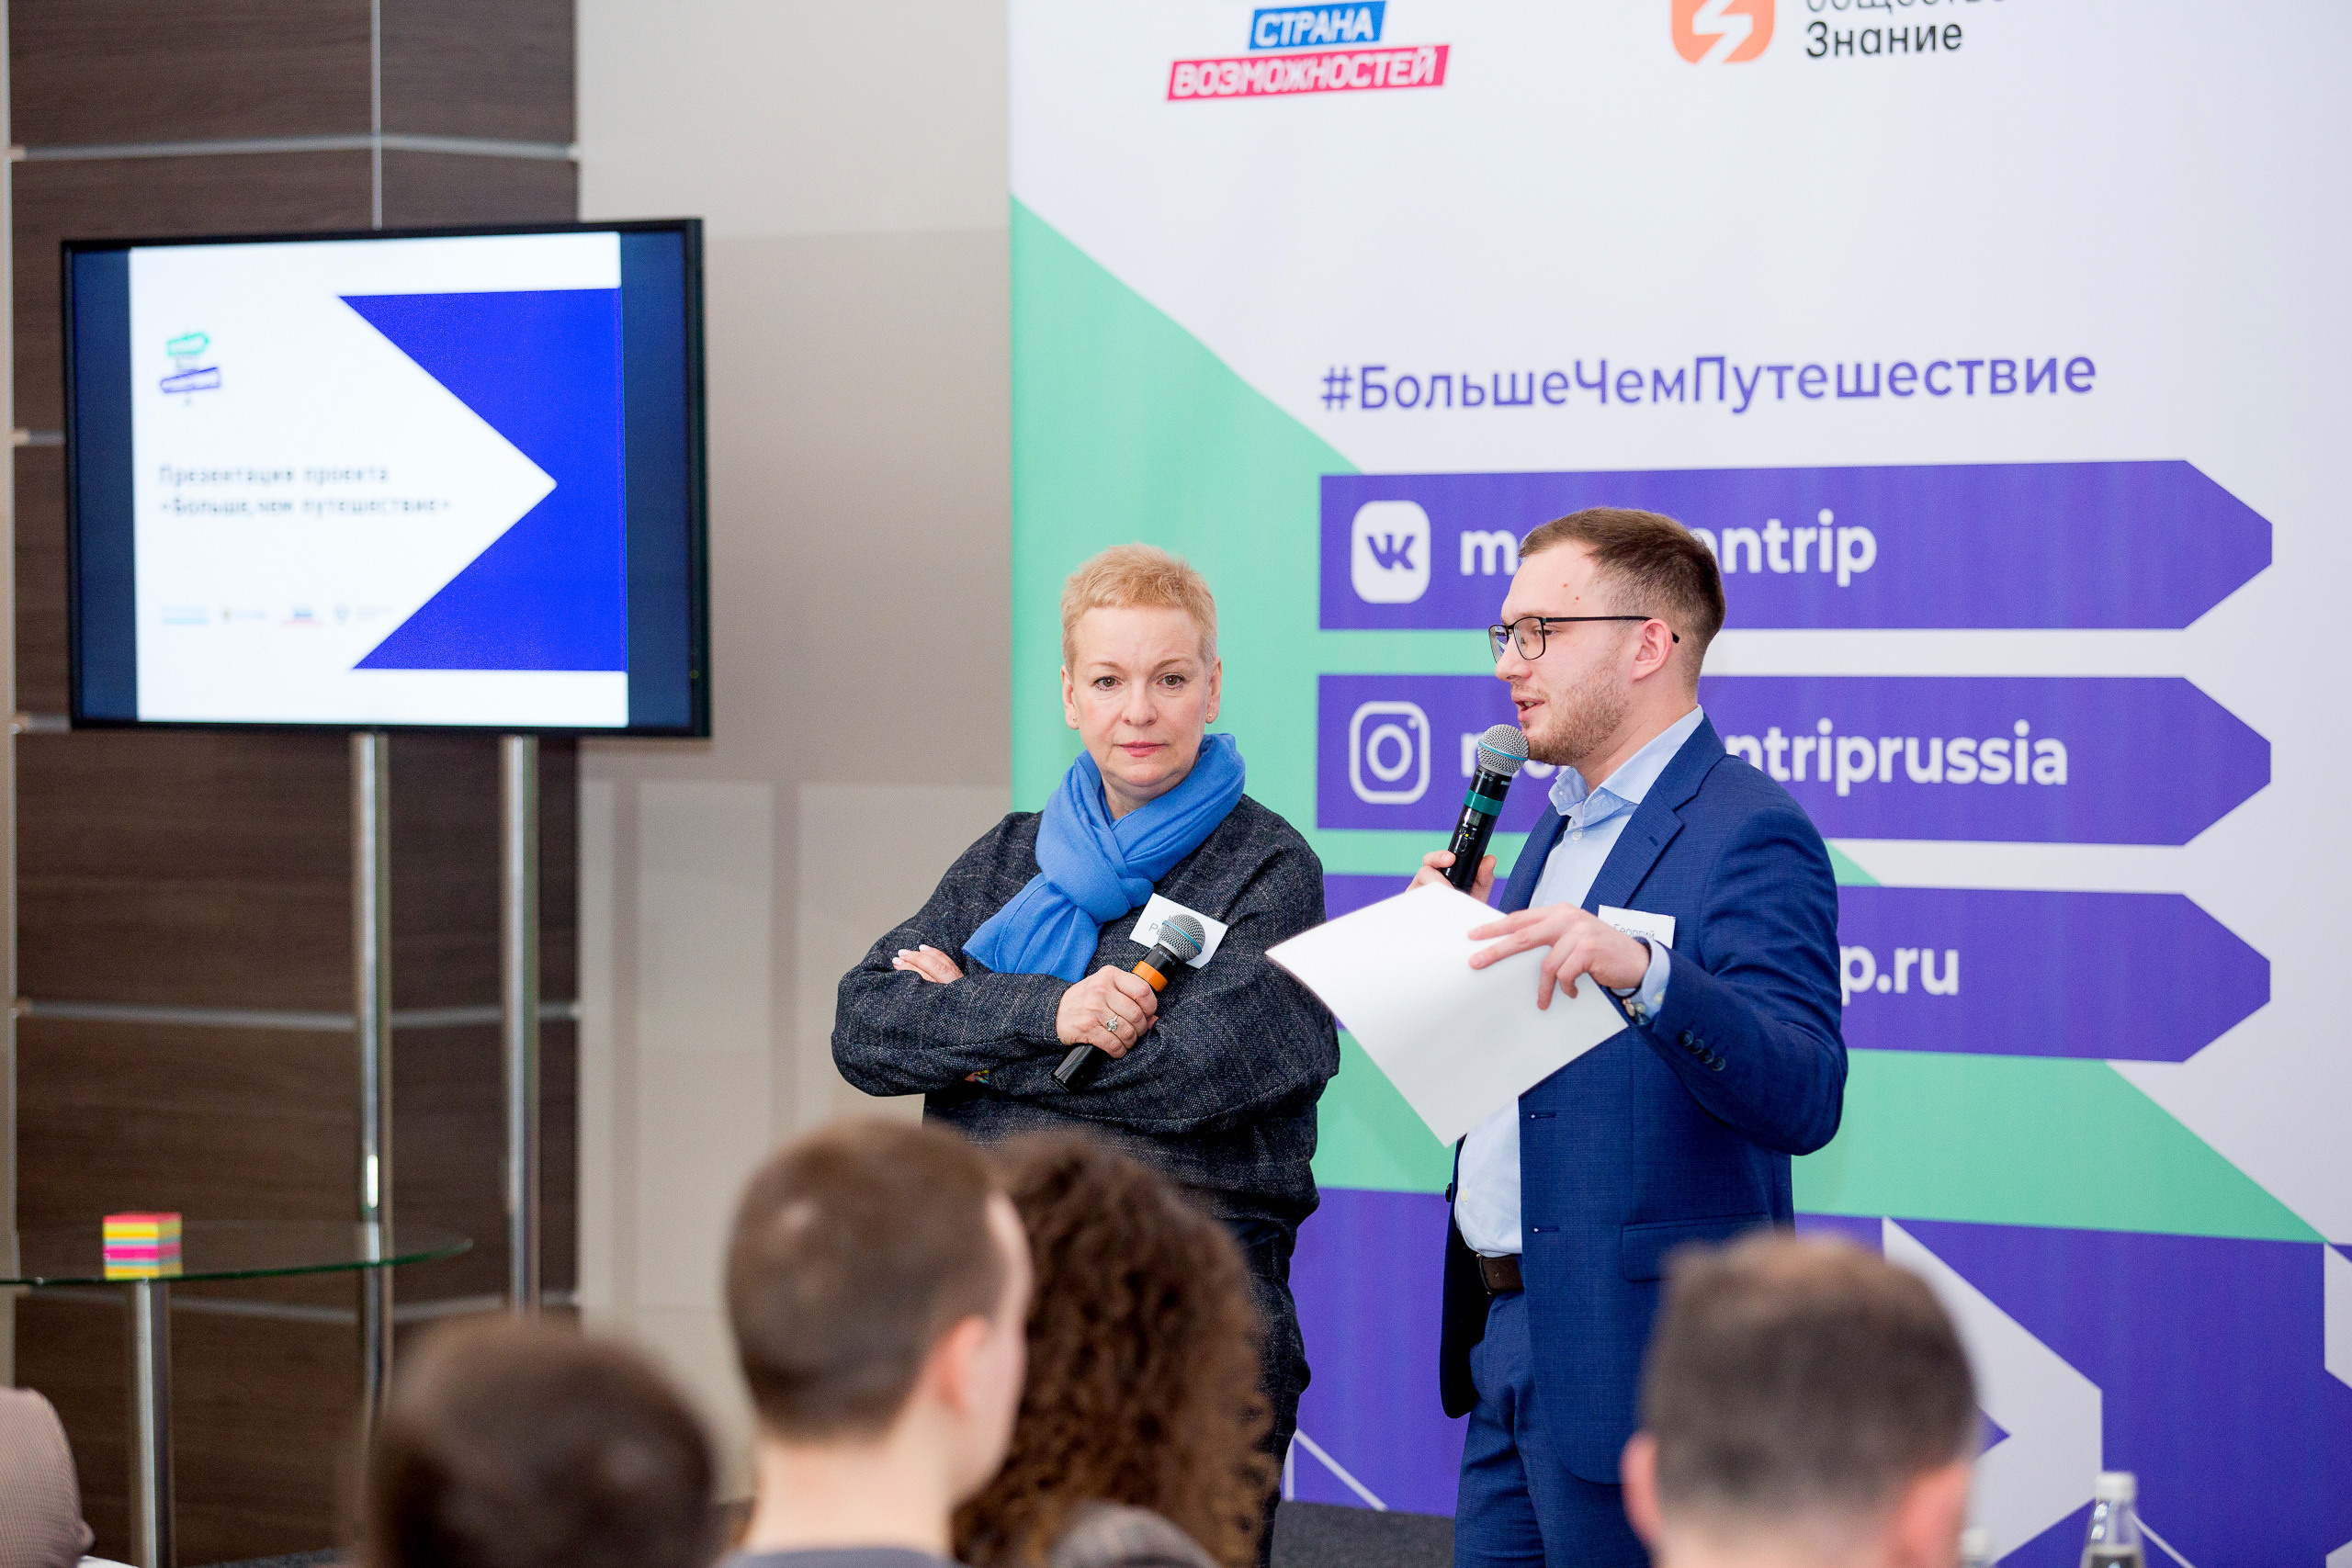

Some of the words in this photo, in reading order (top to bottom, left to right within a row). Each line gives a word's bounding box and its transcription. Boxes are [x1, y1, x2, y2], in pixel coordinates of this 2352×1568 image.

[1254, 6, 1375, 47] СТРАНА
[1806, 20, 1962, 58] Знание
[1171, 46, 1438, 97] ВОЗМОЖНОСТЕЙ
[1321, 355, 2096, 415] #БольшеЧемПутешествие
